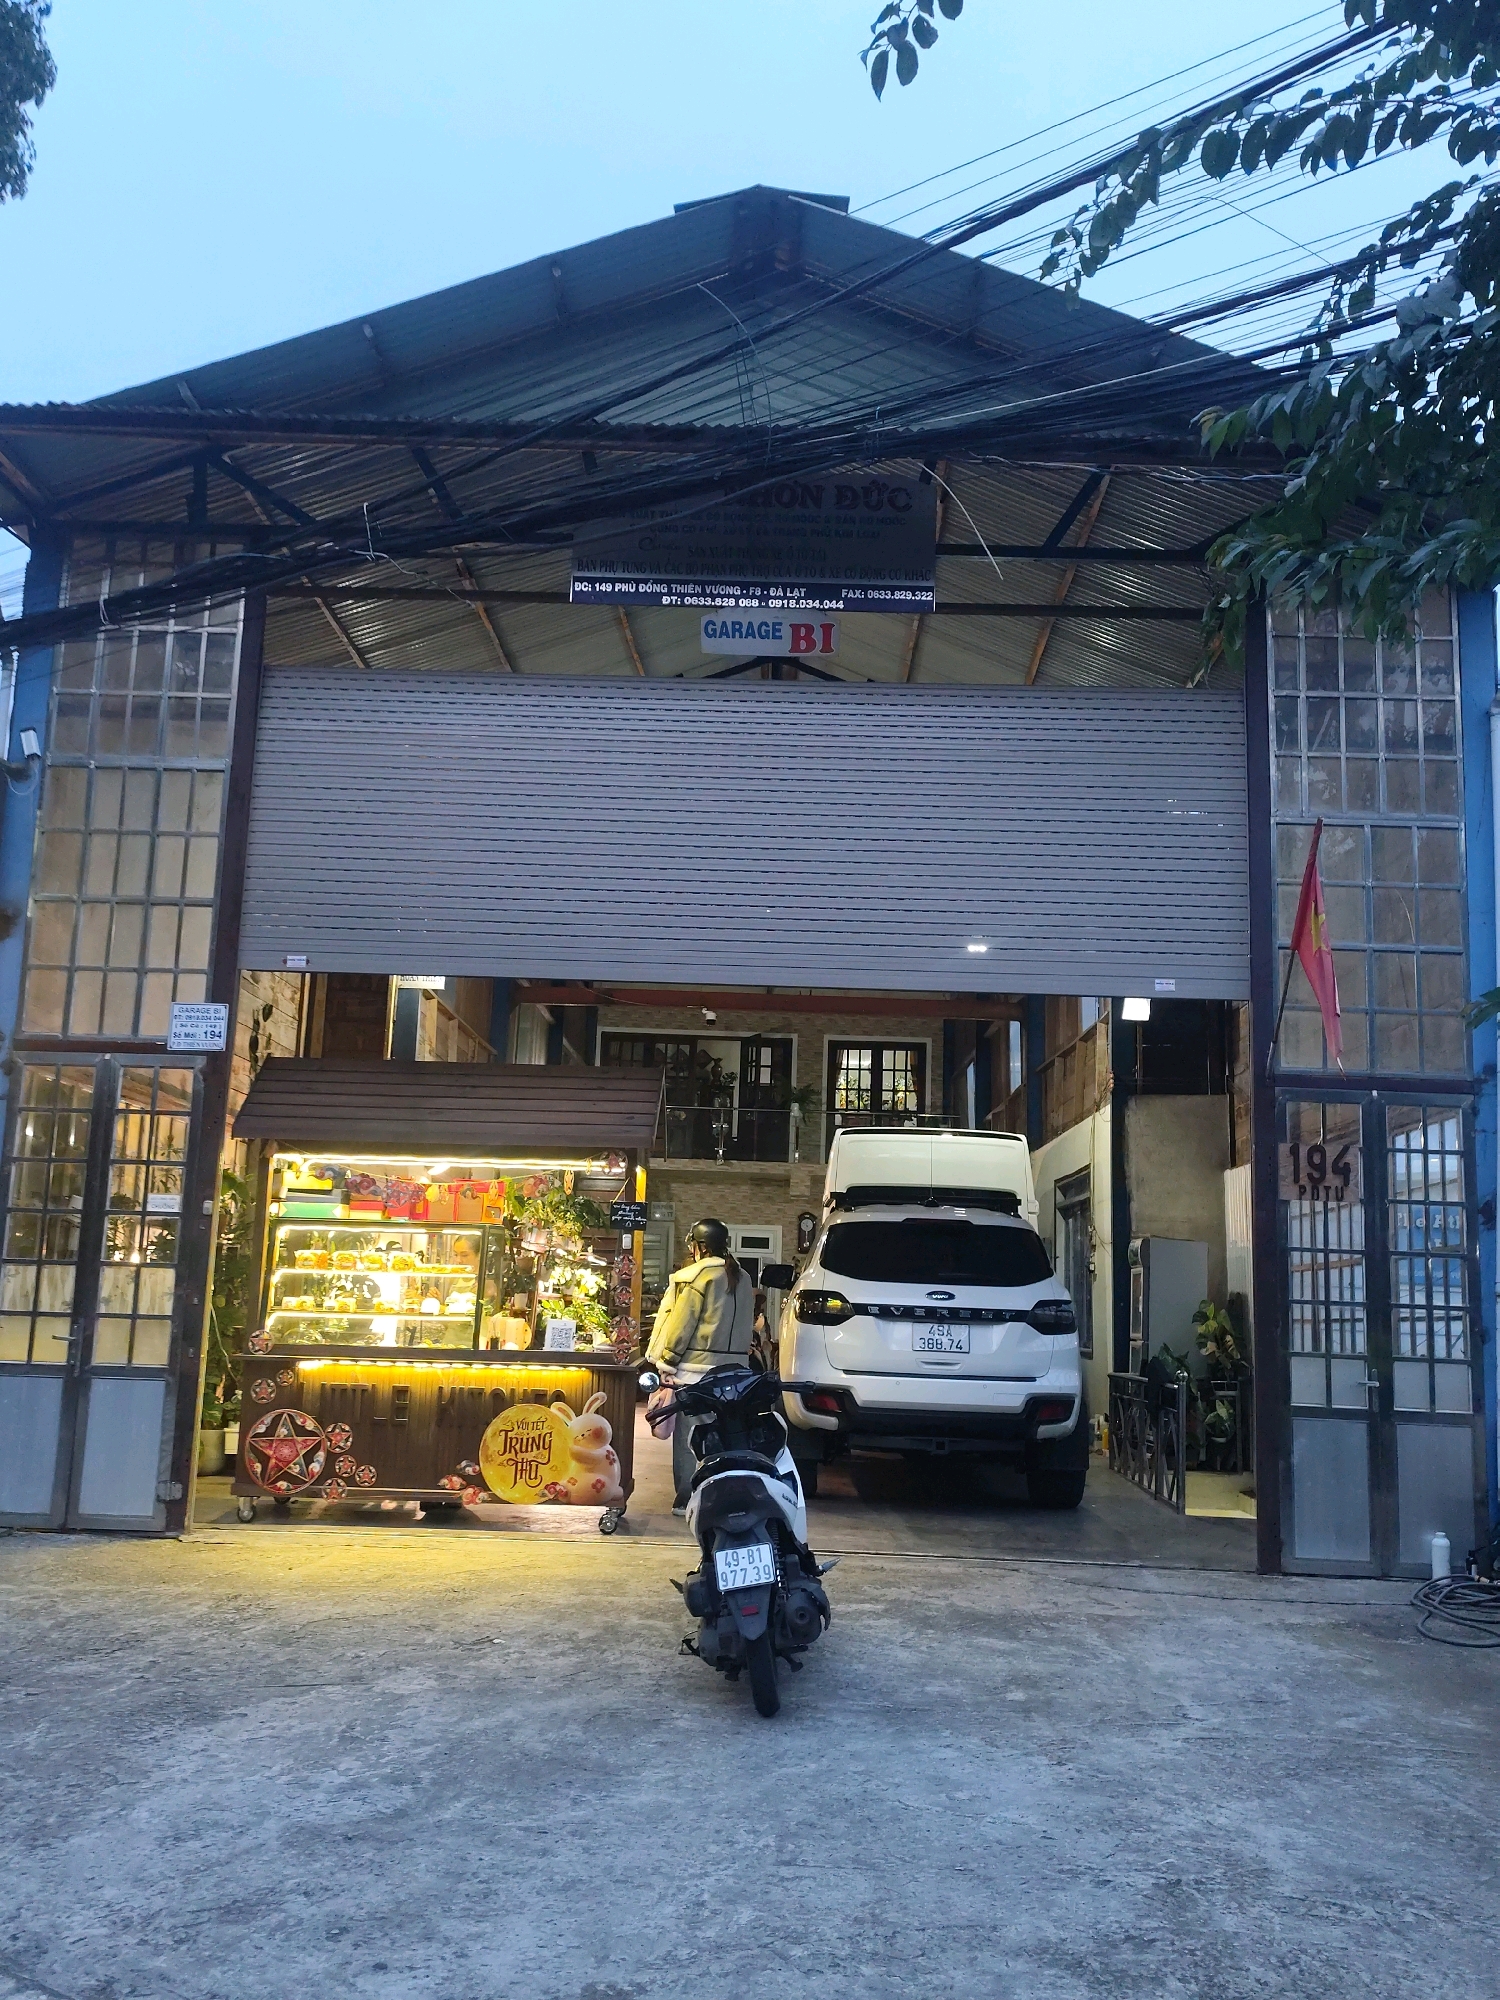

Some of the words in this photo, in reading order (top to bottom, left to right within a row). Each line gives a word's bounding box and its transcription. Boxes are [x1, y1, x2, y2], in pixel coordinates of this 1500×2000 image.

[833, 479, 913, 512] ĐỨC
[573, 581, 592, 592] ĐC:
[594, 582, 613, 593] 149
[614, 581, 636, 593] PHÙ
[670, 580, 702, 594] THIÊN
[704, 584, 741, 596] VƯƠNG
[749, 587, 761, 597] F8
[769, 585, 784, 597] ĐÀ
[786, 587, 806, 599] LẠT
[841, 588, 865, 599] FAX:
[867, 589, 934, 600] 0633.829.322
[661, 596, 681, 606] ĐT:
[684, 596, 736, 607] 0633.828
[768, 599, 844, 609] 0918.034.044
[704, 619, 783, 640] GARAGE
[788, 622, 836, 655] BI
[178, 1006, 212, 1015] GARAGE
[213, 1007, 221, 1015] BI
[203, 1030, 222, 1040] 194
[1290, 1142, 1351, 1187] 194
[867, 1305, 1016, 1320] EVEREST
[928, 1324, 953, 1338] 49A
[516, 1417, 530, 1431] VUI
[531, 1416, 548, 1431] TẾT
[497, 1426, 553, 1461] TRUNG
[724, 1547, 763, 1568] 49-B1
[720, 1564, 772, 1588] 977.39
